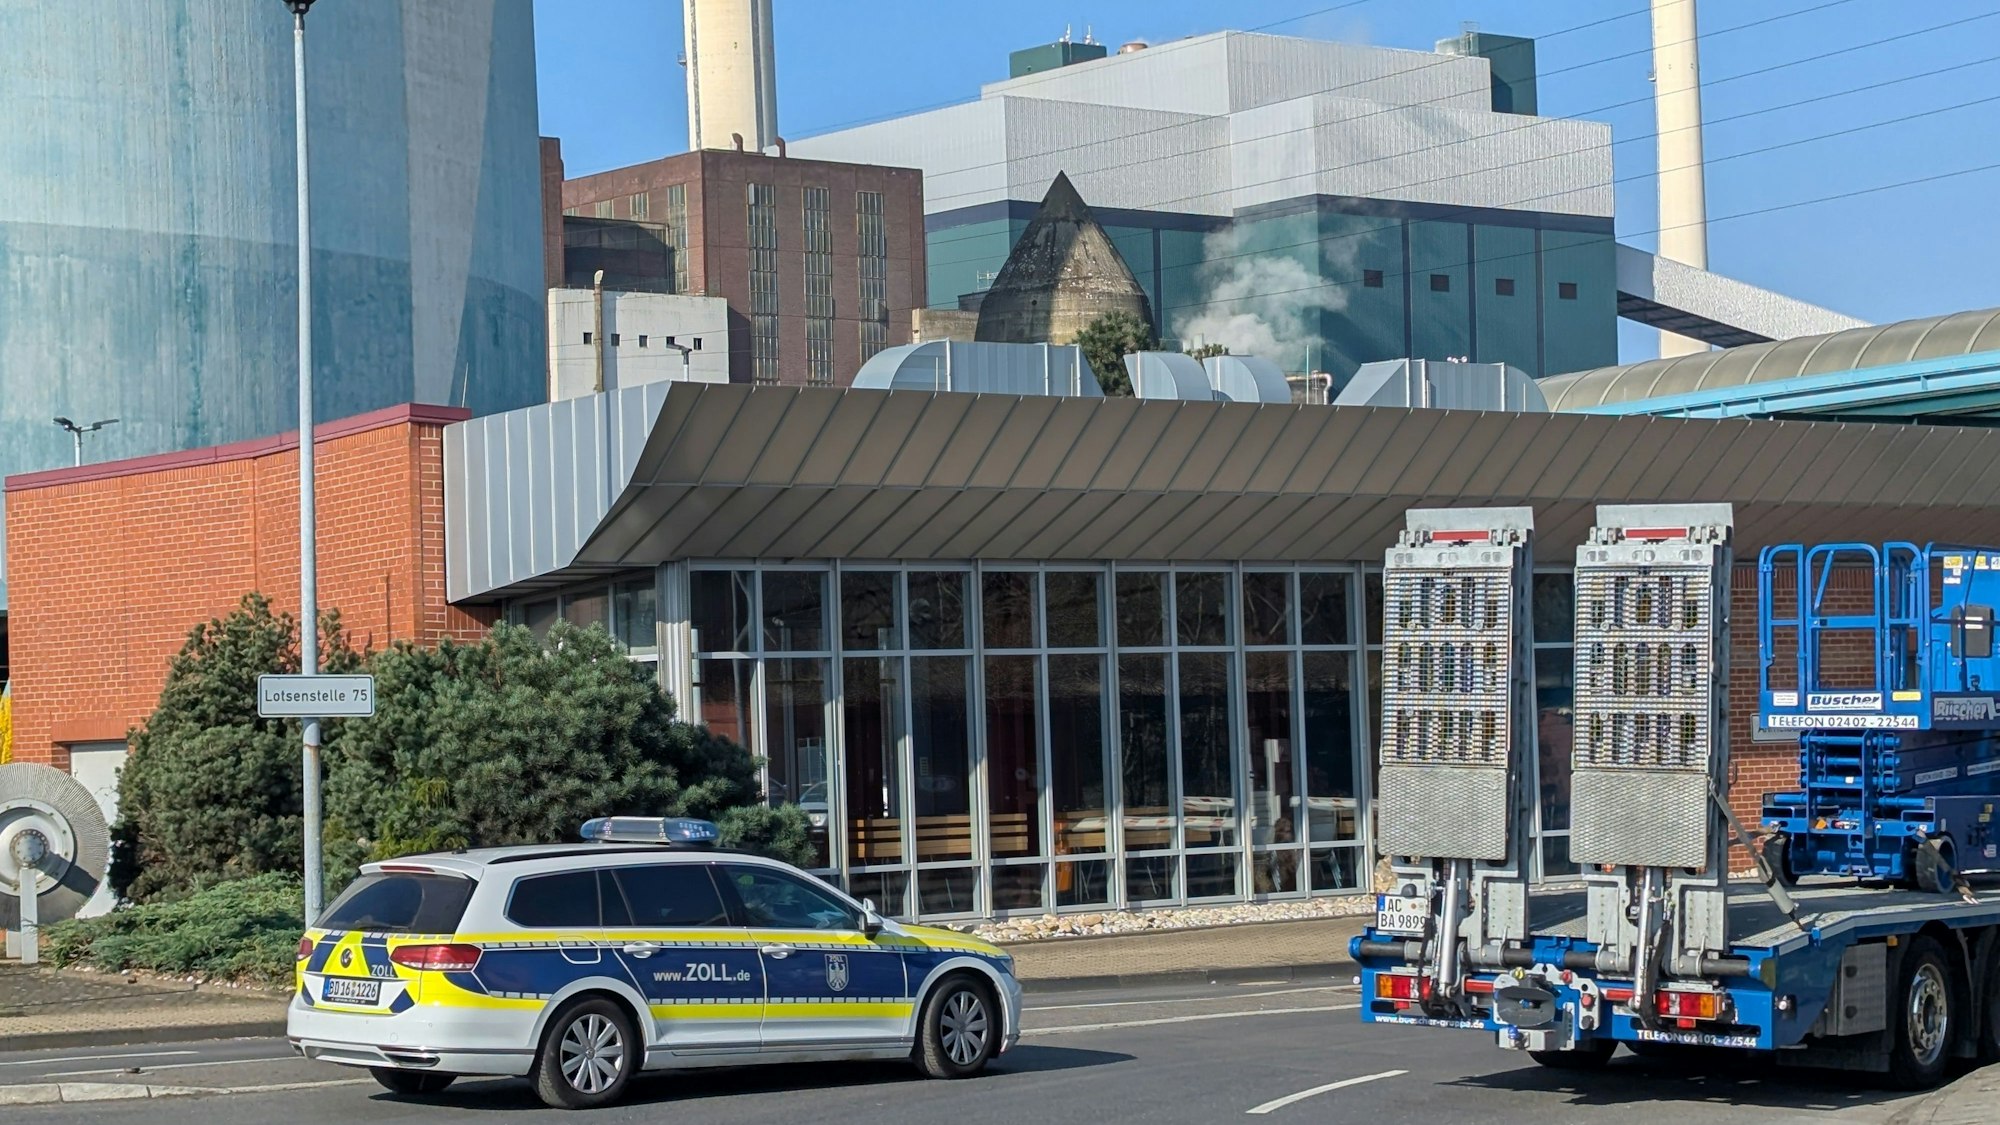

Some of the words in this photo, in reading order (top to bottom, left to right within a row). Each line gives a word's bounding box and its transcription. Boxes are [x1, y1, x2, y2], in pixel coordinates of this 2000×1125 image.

[264, 689, 346, 702] Lotsenstelle
[352, 689, 368, 702] 75
[1810, 695, 1880, 706] Büscher
[1771, 716, 1824, 727] TELEFON
[1388, 899, 1402, 912] AC
[1381, 913, 1395, 927] BA
[1398, 915, 1426, 929] 9899
[371, 964, 395, 977] ZOLL
[653, 963, 751, 982] www.ZOLL.de
[356, 984, 377, 998] 1226
[1637, 1029, 1681, 1042] TELEFON
